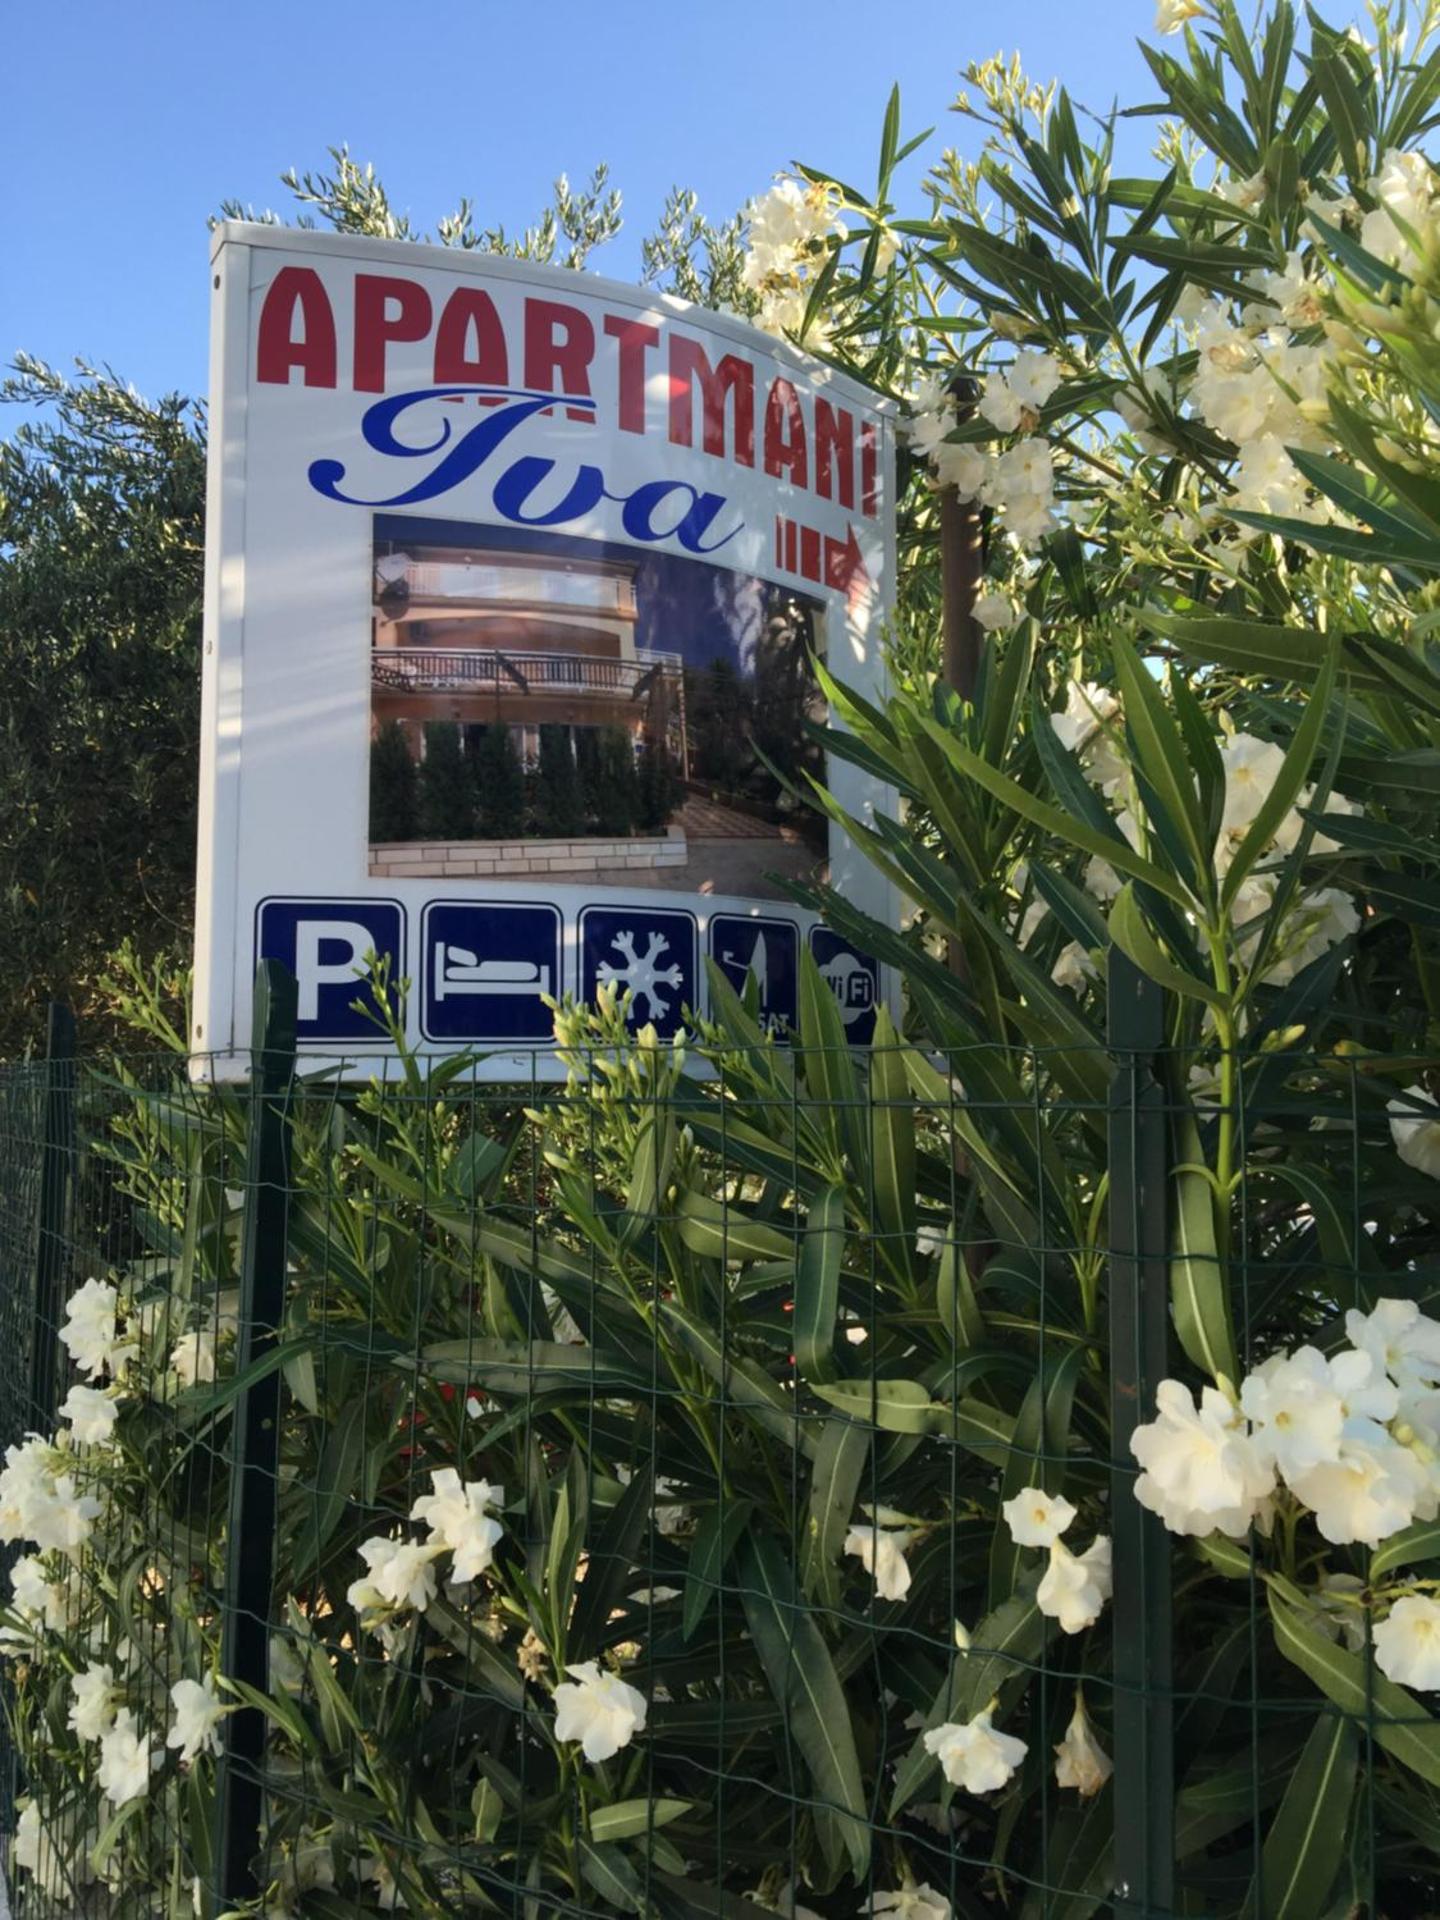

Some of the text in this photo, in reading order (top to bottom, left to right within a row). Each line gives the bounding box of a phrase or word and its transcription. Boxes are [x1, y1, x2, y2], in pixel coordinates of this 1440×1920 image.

[257, 266, 877, 520] APARTMANI
[308, 387, 745, 553] Iva
[296, 920, 377, 1021] P
